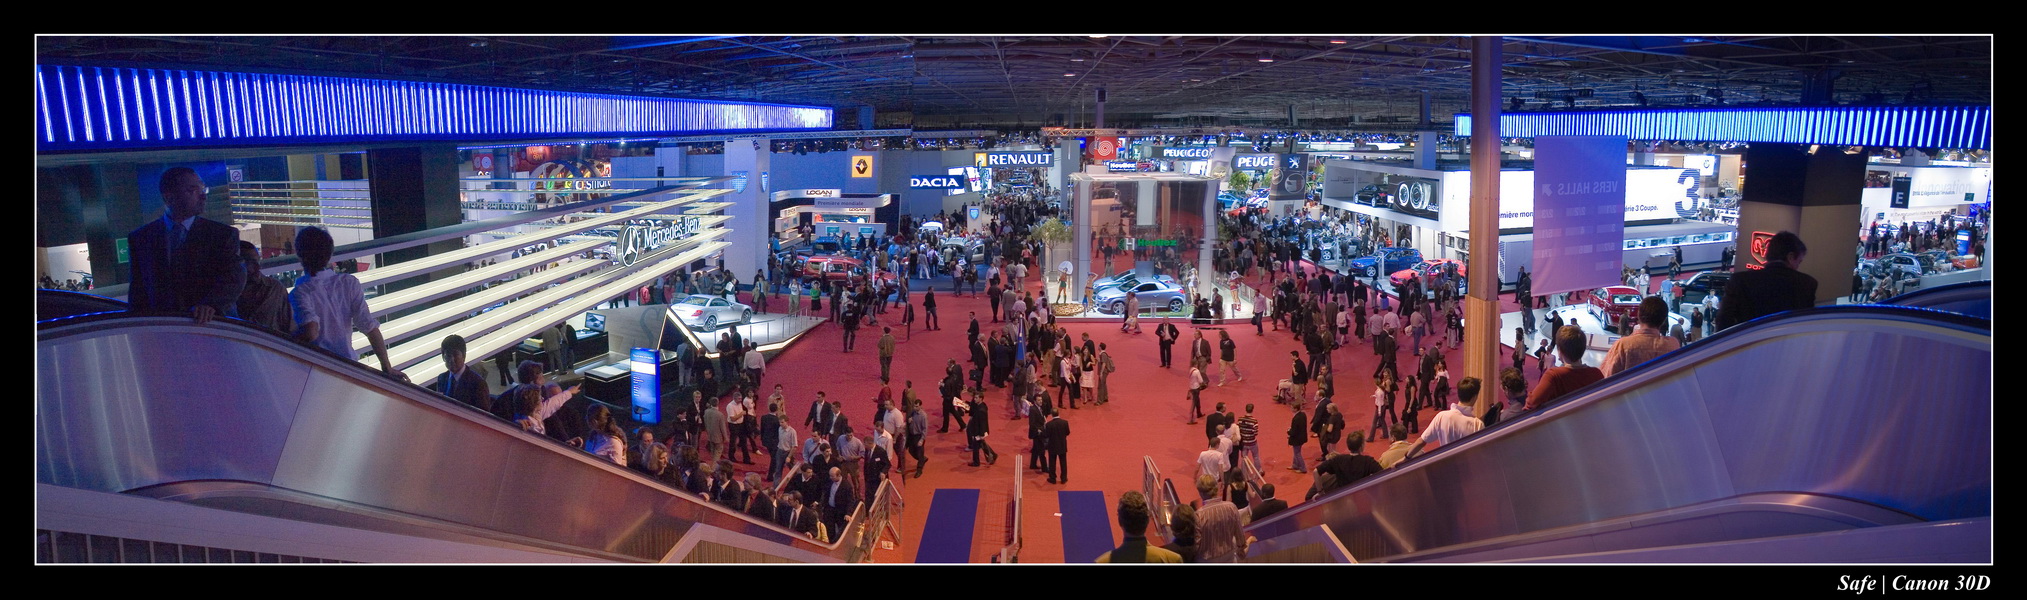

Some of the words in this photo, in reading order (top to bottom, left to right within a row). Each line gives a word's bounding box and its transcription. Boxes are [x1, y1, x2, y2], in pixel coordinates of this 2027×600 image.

[989, 153, 1053, 165] RENAULT
[910, 177, 960, 187] DACIA
[1675, 169, 1700, 218] 3
[1895, 191, 1905, 204] E
[643, 217, 702, 250] Mercedes-Benz
